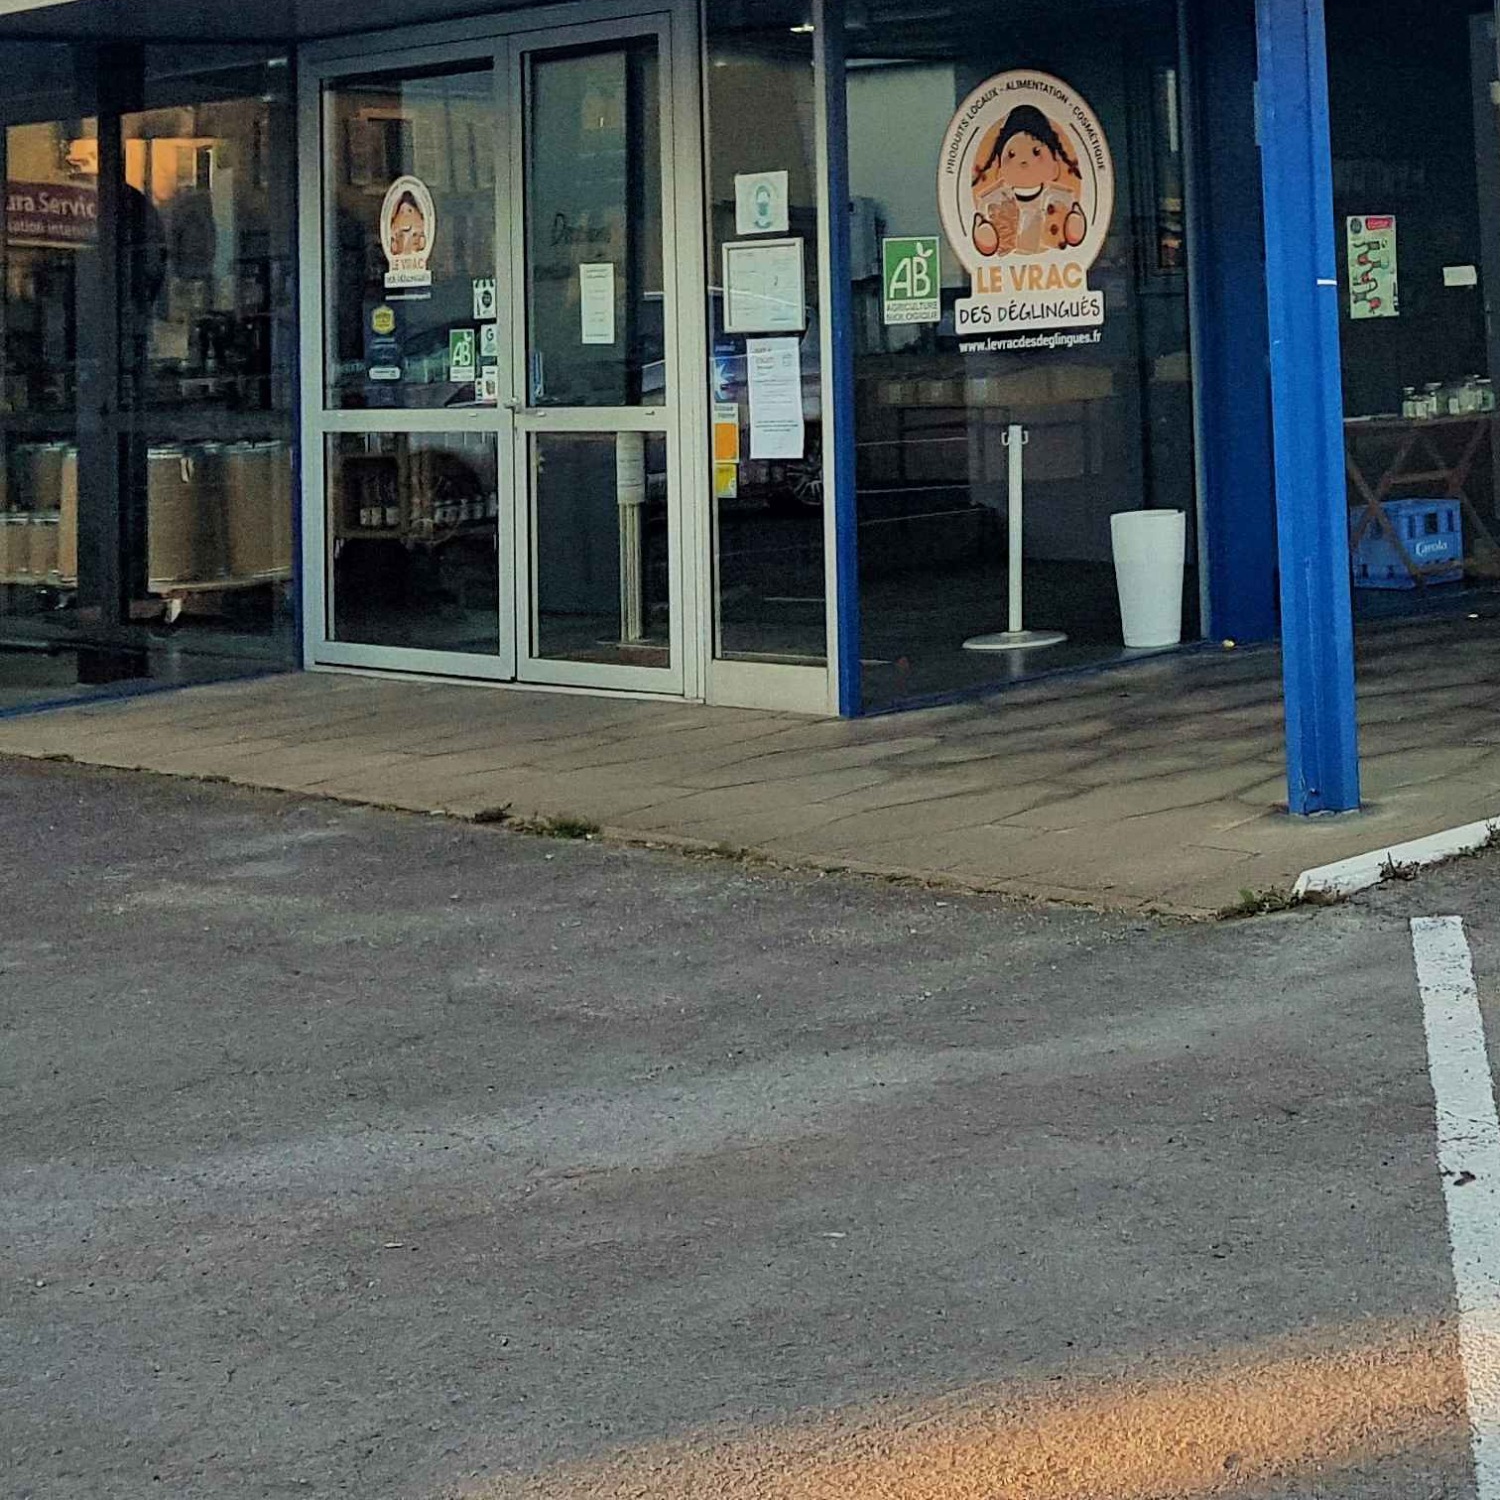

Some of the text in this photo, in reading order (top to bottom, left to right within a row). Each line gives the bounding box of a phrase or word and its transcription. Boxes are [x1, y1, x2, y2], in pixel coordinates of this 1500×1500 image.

[945, 117, 970, 174] PRODUITS
[967, 86, 999, 120] LOCAUX
[1005, 78, 1070, 104] ALIMENTATION
[889, 257, 931, 299] AB
[977, 261, 1083, 294] LE VRAC
[959, 296, 1100, 324] DES DÉGLINGUÉS
[453, 341, 471, 366] AB
[958, 328, 1102, 353] www.levracdesdeglingues.fr
